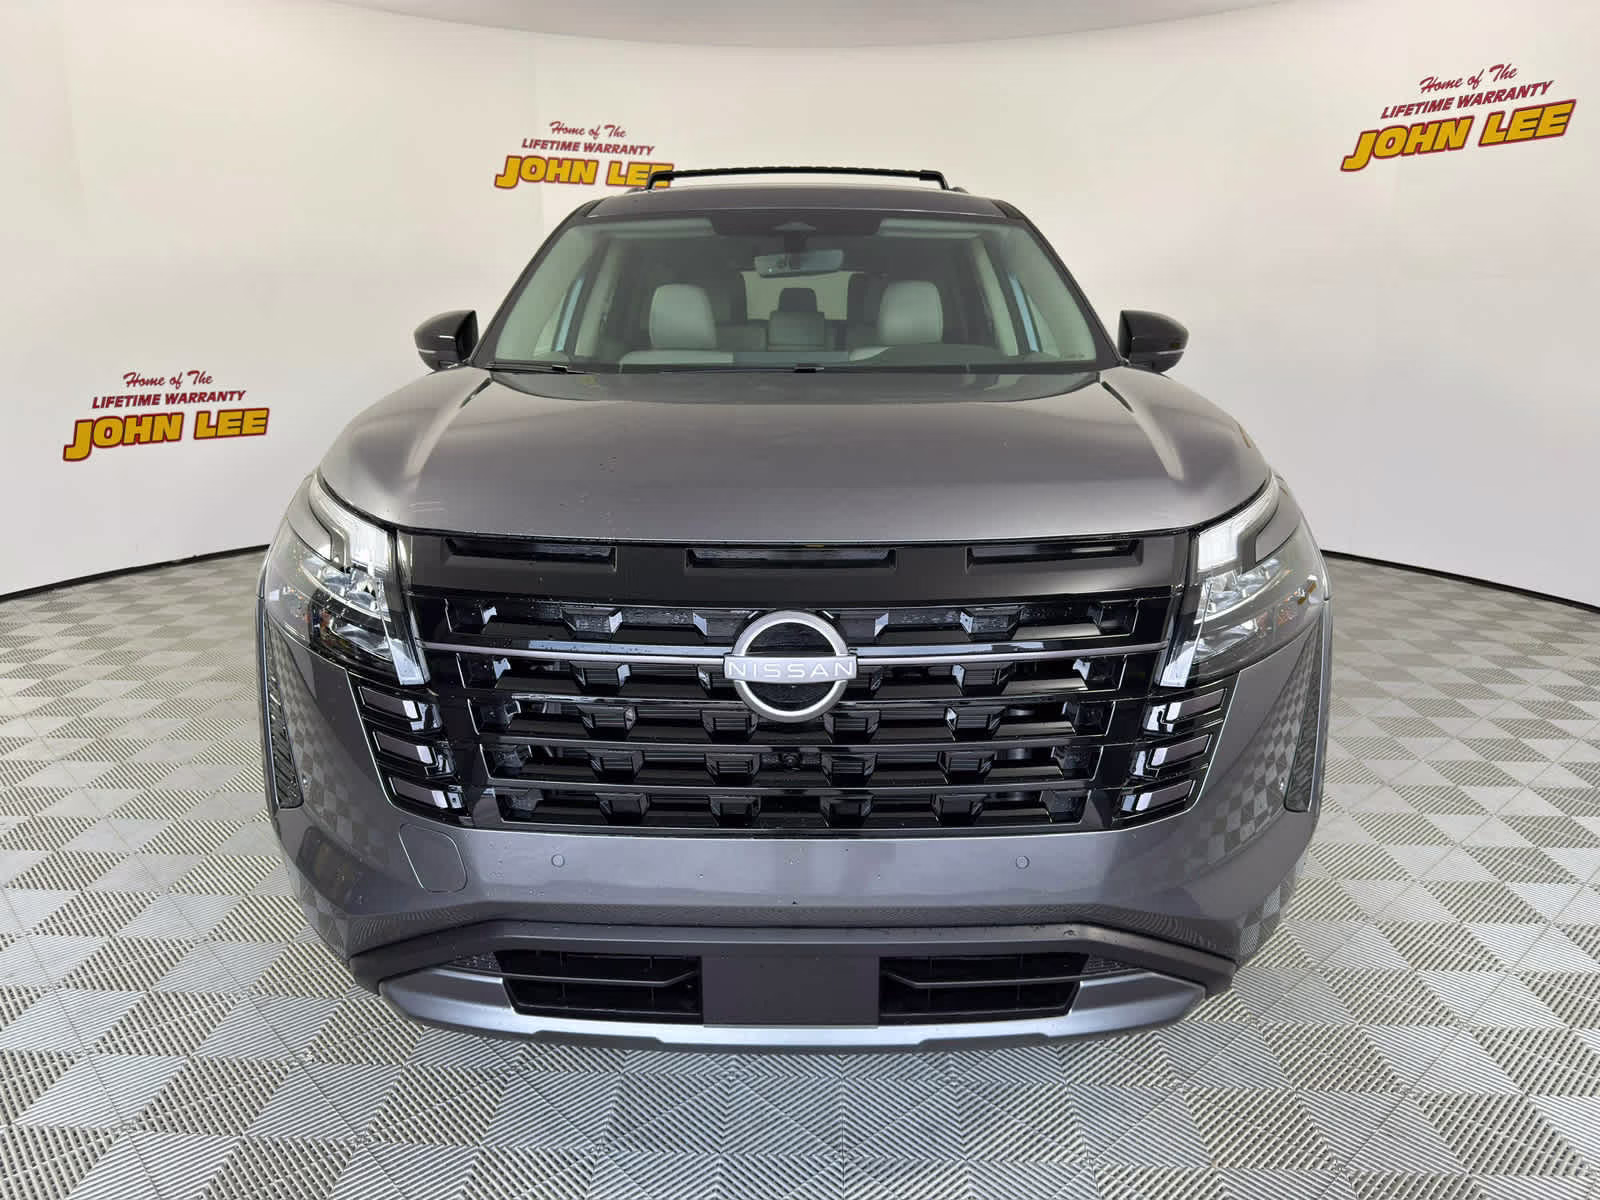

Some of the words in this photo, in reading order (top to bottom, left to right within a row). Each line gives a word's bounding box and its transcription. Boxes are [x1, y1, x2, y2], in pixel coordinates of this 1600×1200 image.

[1419, 76, 1463, 94] Home
[1467, 69, 1484, 89] of
[1489, 63, 1517, 82] The
[1380, 97, 1455, 119] LIFETIME
[1457, 80, 1554, 108] WARRANTY
[550, 121, 585, 135] Home
[588, 125, 600, 140] of
[604, 124, 626, 138] The
[1341, 115, 1474, 172] JOHN
[1478, 99, 1576, 147] LEE
[521, 138, 581, 152] LIFETIME
[583, 142, 655, 156] WARRANTY
[494, 155, 599, 189] JOHN
[123, 372, 165, 387] Home
[169, 372, 182, 389] of
[187, 370, 213, 385] The
[92, 394, 161, 409] LIFETIME
[165, 390, 246, 405] WARRANTY
[63, 412, 184, 462] JOHN
[194, 408, 269, 440] LEE
[728, 662, 853, 678] NISSAN
